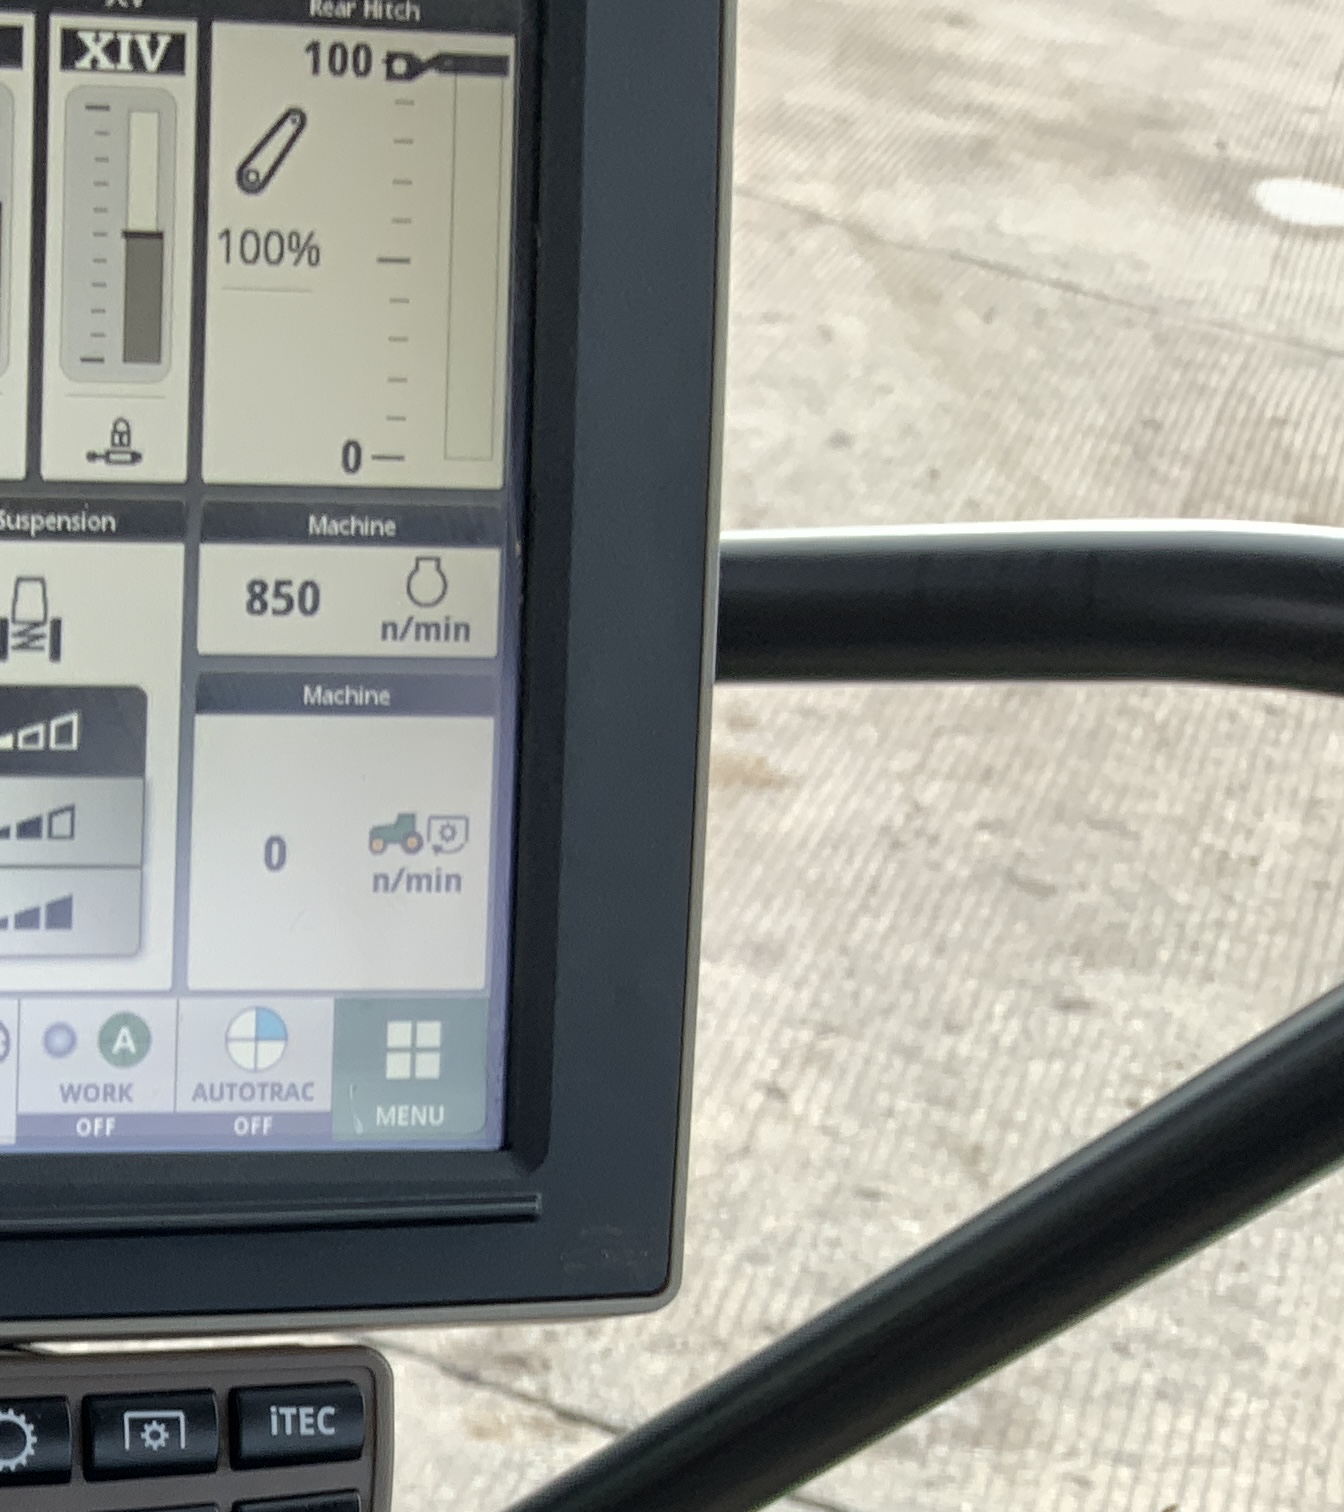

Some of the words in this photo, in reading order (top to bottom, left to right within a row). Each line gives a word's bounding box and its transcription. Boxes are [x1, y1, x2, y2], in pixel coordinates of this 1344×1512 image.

[309, 0, 357, 18] Rear
[363, 0, 421, 22] Hitch
[74, 32, 171, 72] XIV
[304, 40, 373, 77] 100
[217, 228, 320, 268] 100%
[341, 440, 362, 474] 0
[308, 514, 396, 538] Machine
[245, 579, 321, 616] 850
[380, 617, 471, 642] n/min
[303, 683, 390, 706] Machine
[264, 835, 286, 872] 0
[372, 868, 462, 894] n/min
[112, 1025, 137, 1054] A
[59, 1082, 133, 1103] WORK
[192, 1081, 315, 1102] AUTOTRAC
[75, 1117, 115, 1137] OFF
[233, 1115, 273, 1137] OFF
[375, 1105, 444, 1128] MENU
[270, 1406, 335, 1436] iTEC
